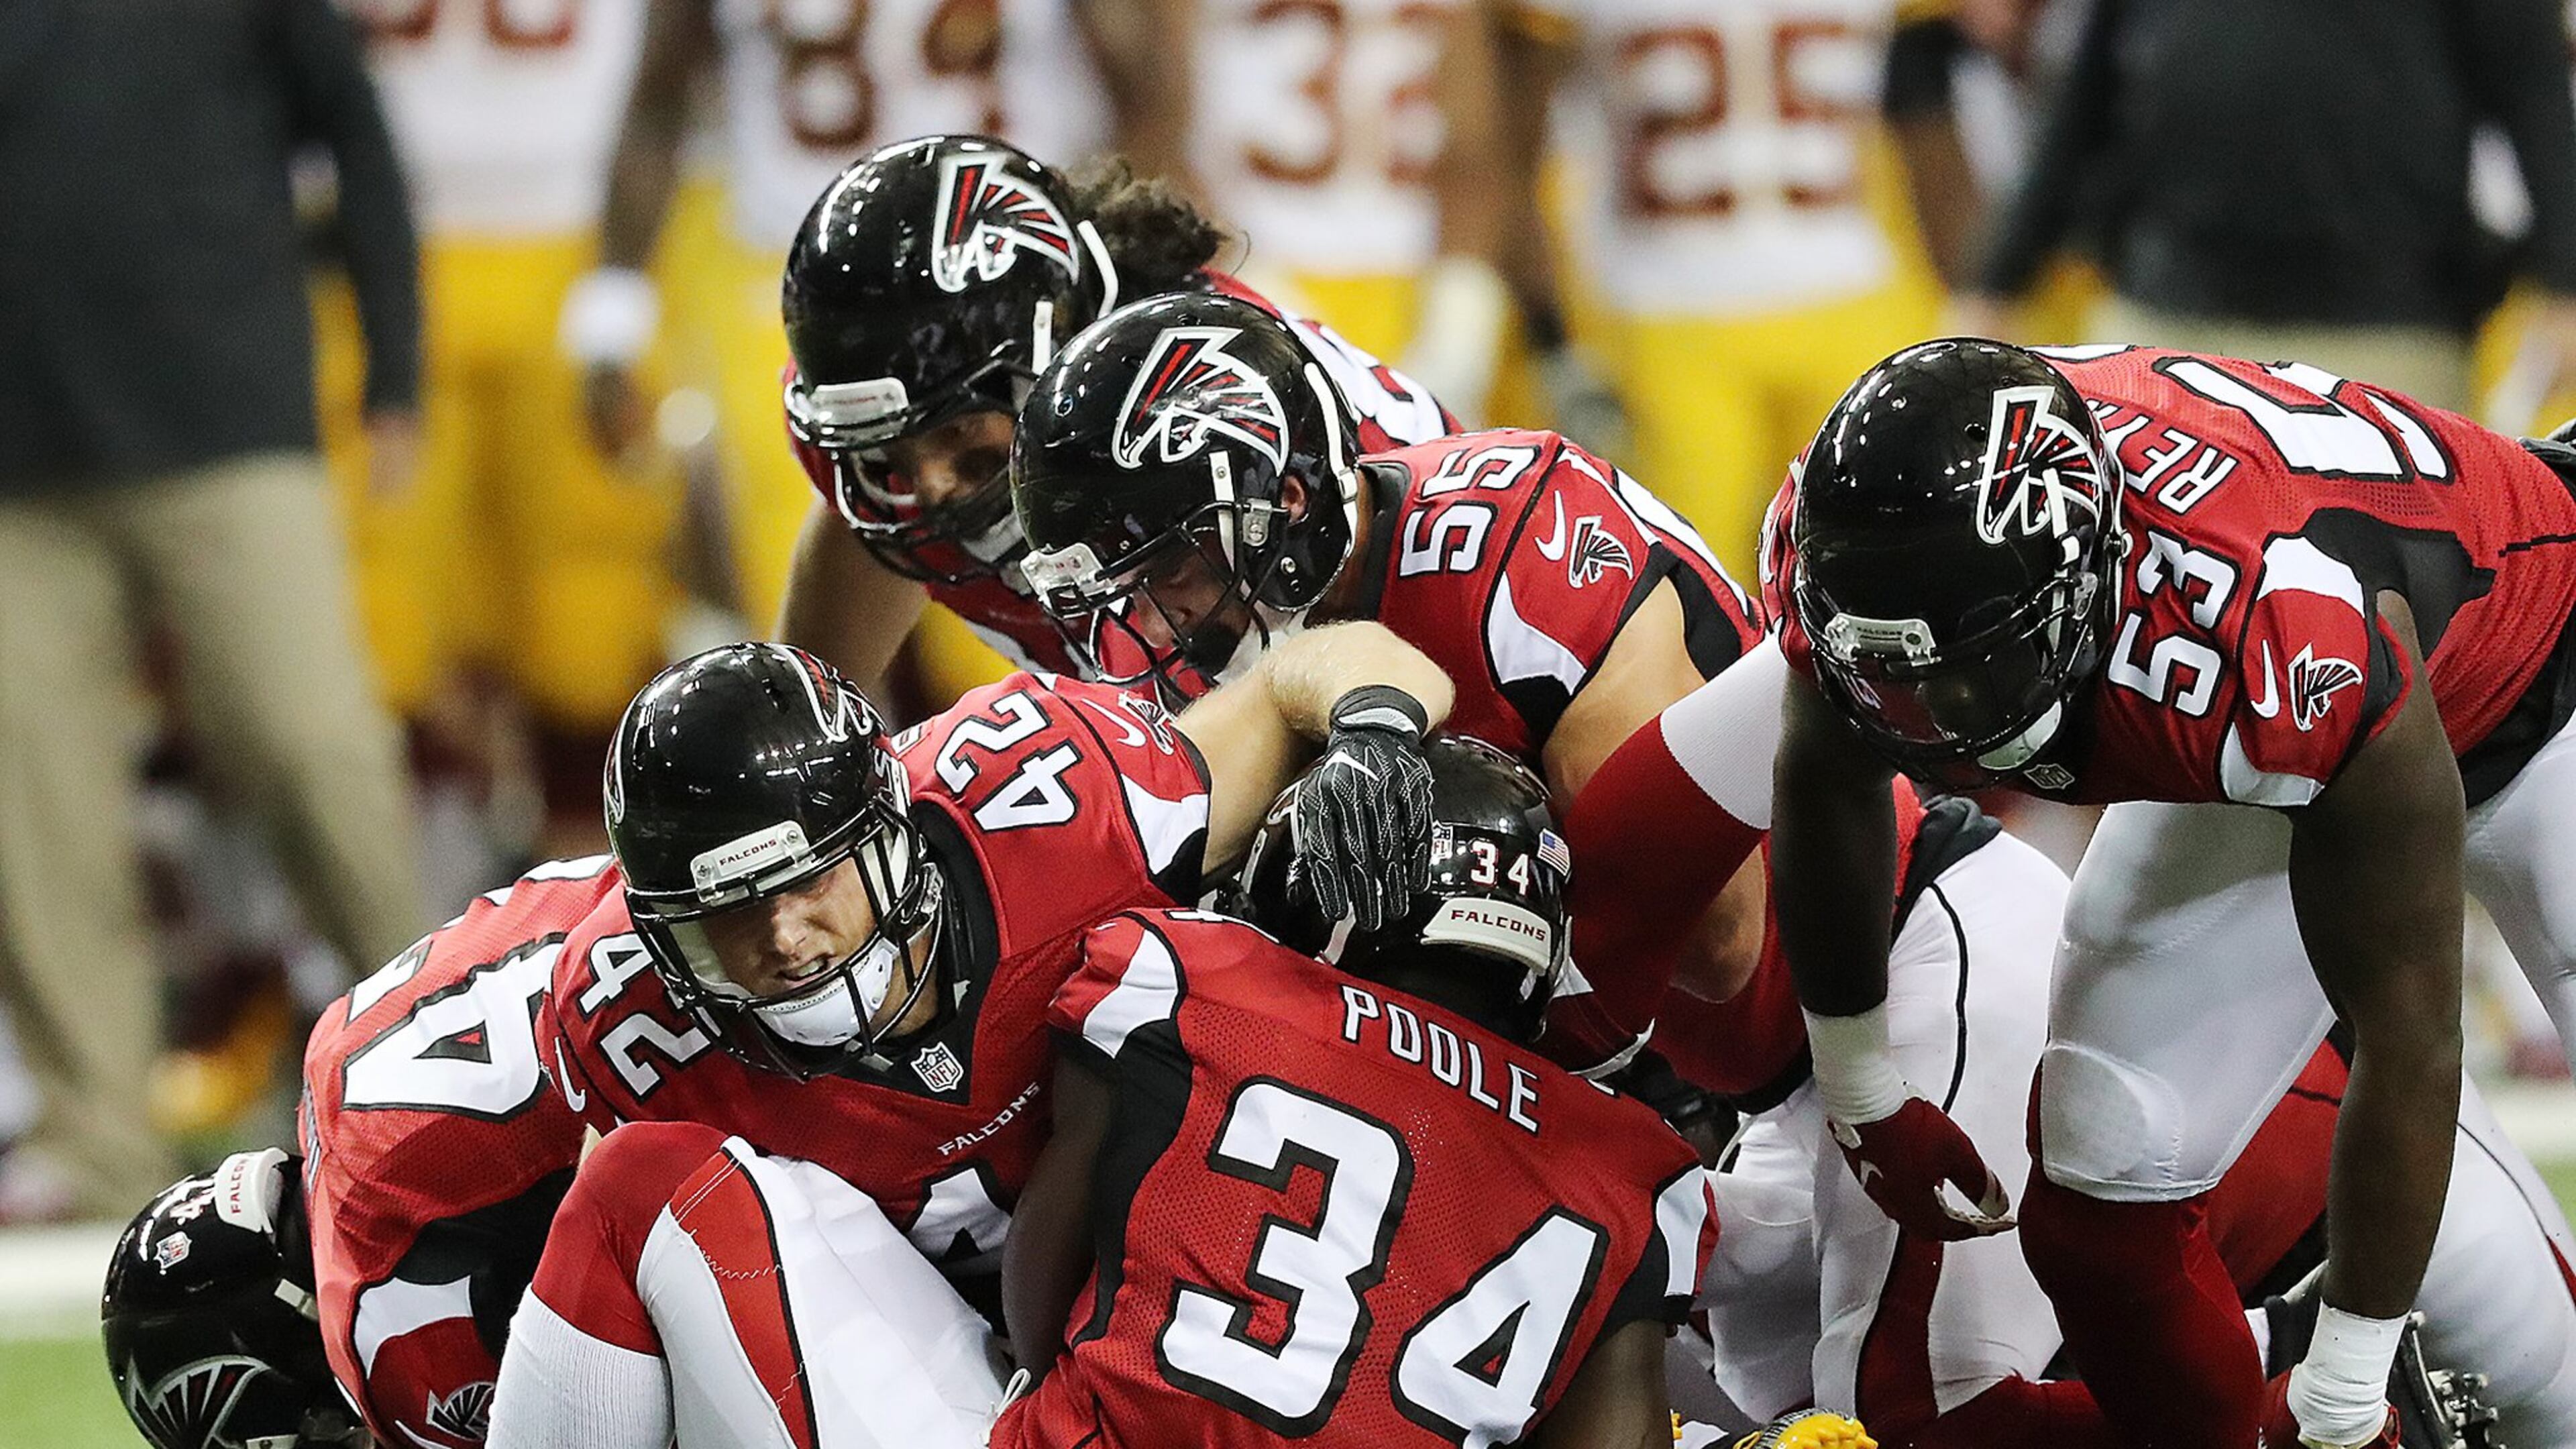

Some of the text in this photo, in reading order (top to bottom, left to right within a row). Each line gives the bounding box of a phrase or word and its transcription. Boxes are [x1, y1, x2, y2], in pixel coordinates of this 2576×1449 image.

[1615, 21, 1868, 221] 25
[1399, 445, 1542, 578] 55
[2108, 529, 2242, 718] 53
[934, 690, 1084, 833] 42
[719, 839, 777, 867] FALCONS
[1470, 840, 1530, 897] 34
[1450, 909, 1547, 942] FALCONS
[577, 930, 713, 1104] 42
[1340, 984, 1540, 1134] POOLE
[936, 1081, 1040, 1156] FALCONS
[1155, 1073, 1611, 1449] 34
